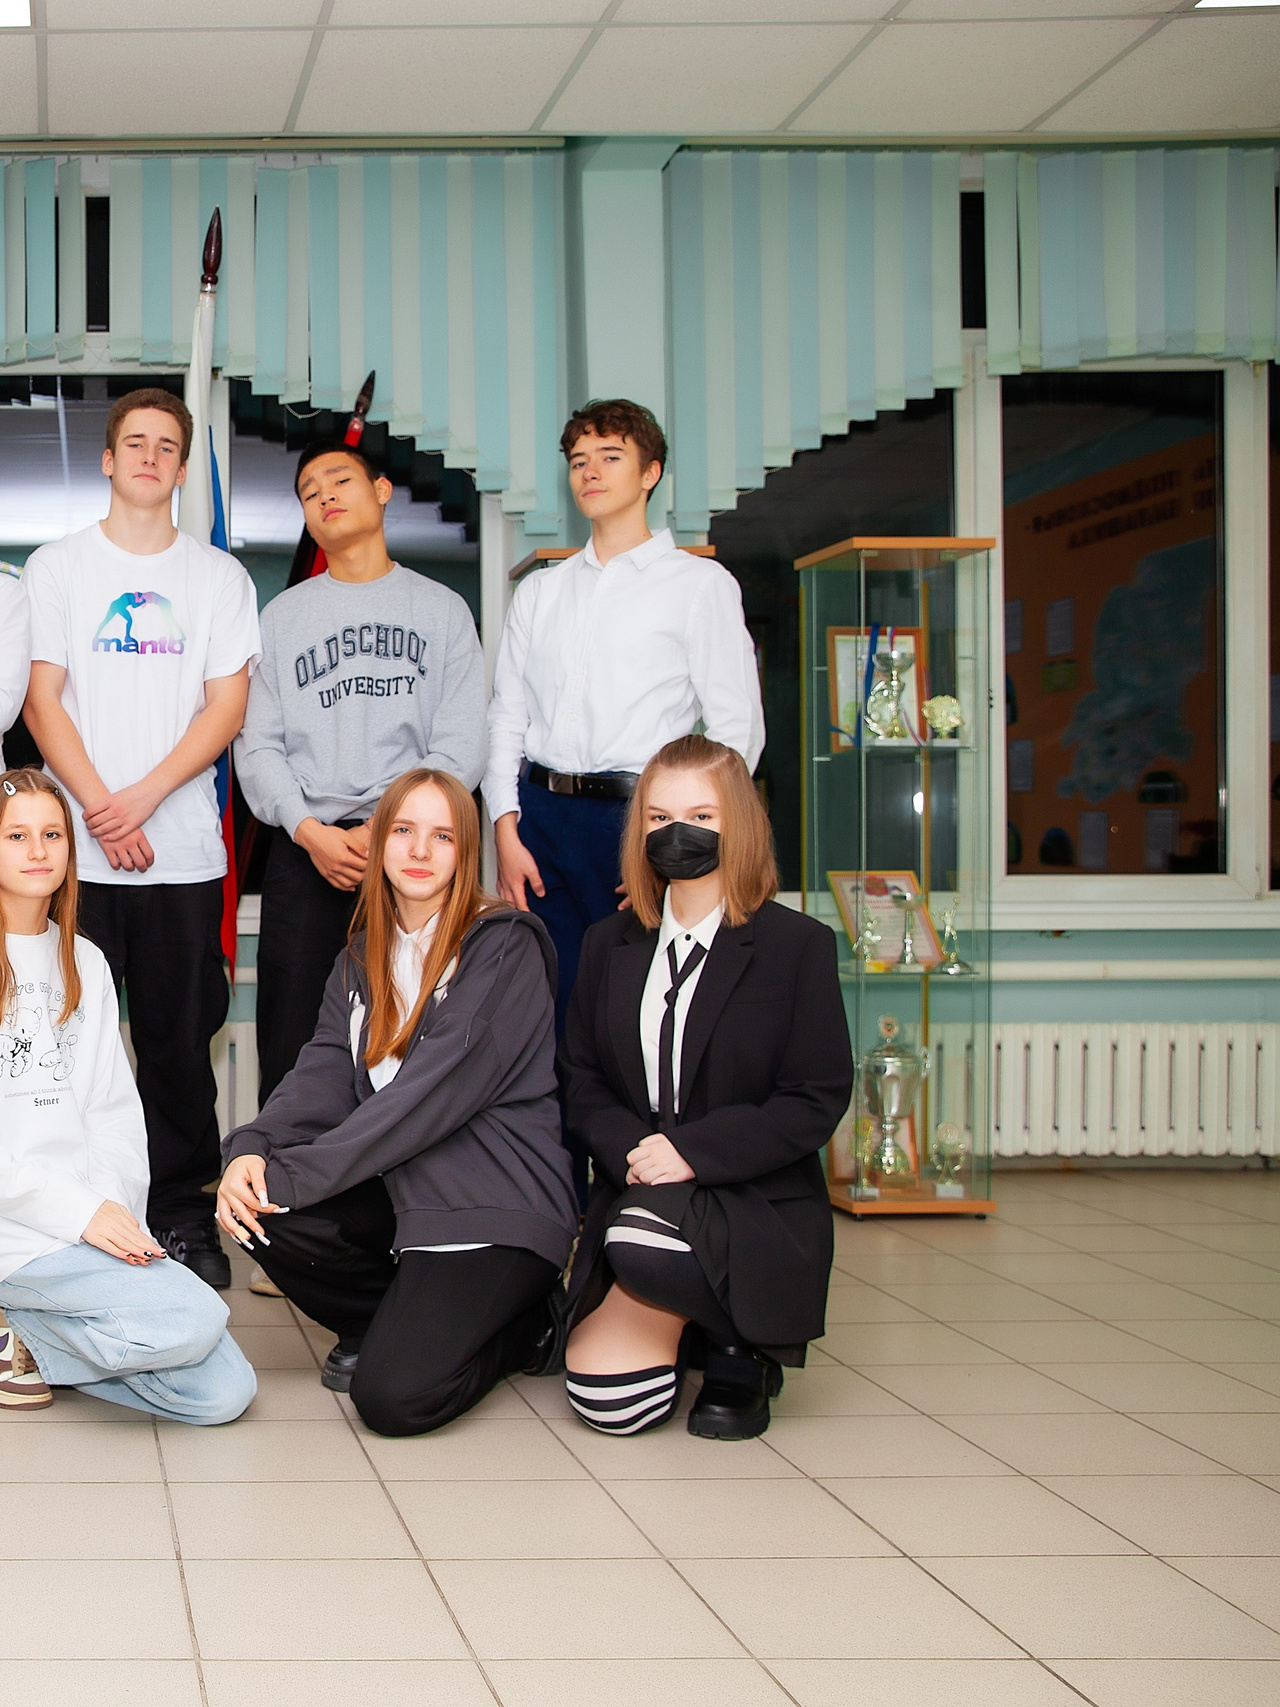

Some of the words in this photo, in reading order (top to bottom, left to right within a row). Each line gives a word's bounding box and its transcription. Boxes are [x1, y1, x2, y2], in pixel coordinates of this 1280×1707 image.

[92, 636, 185, 655] manto
[294, 622, 428, 690] OLDSCHOOL
[318, 675, 416, 708] UNIVERSITY
